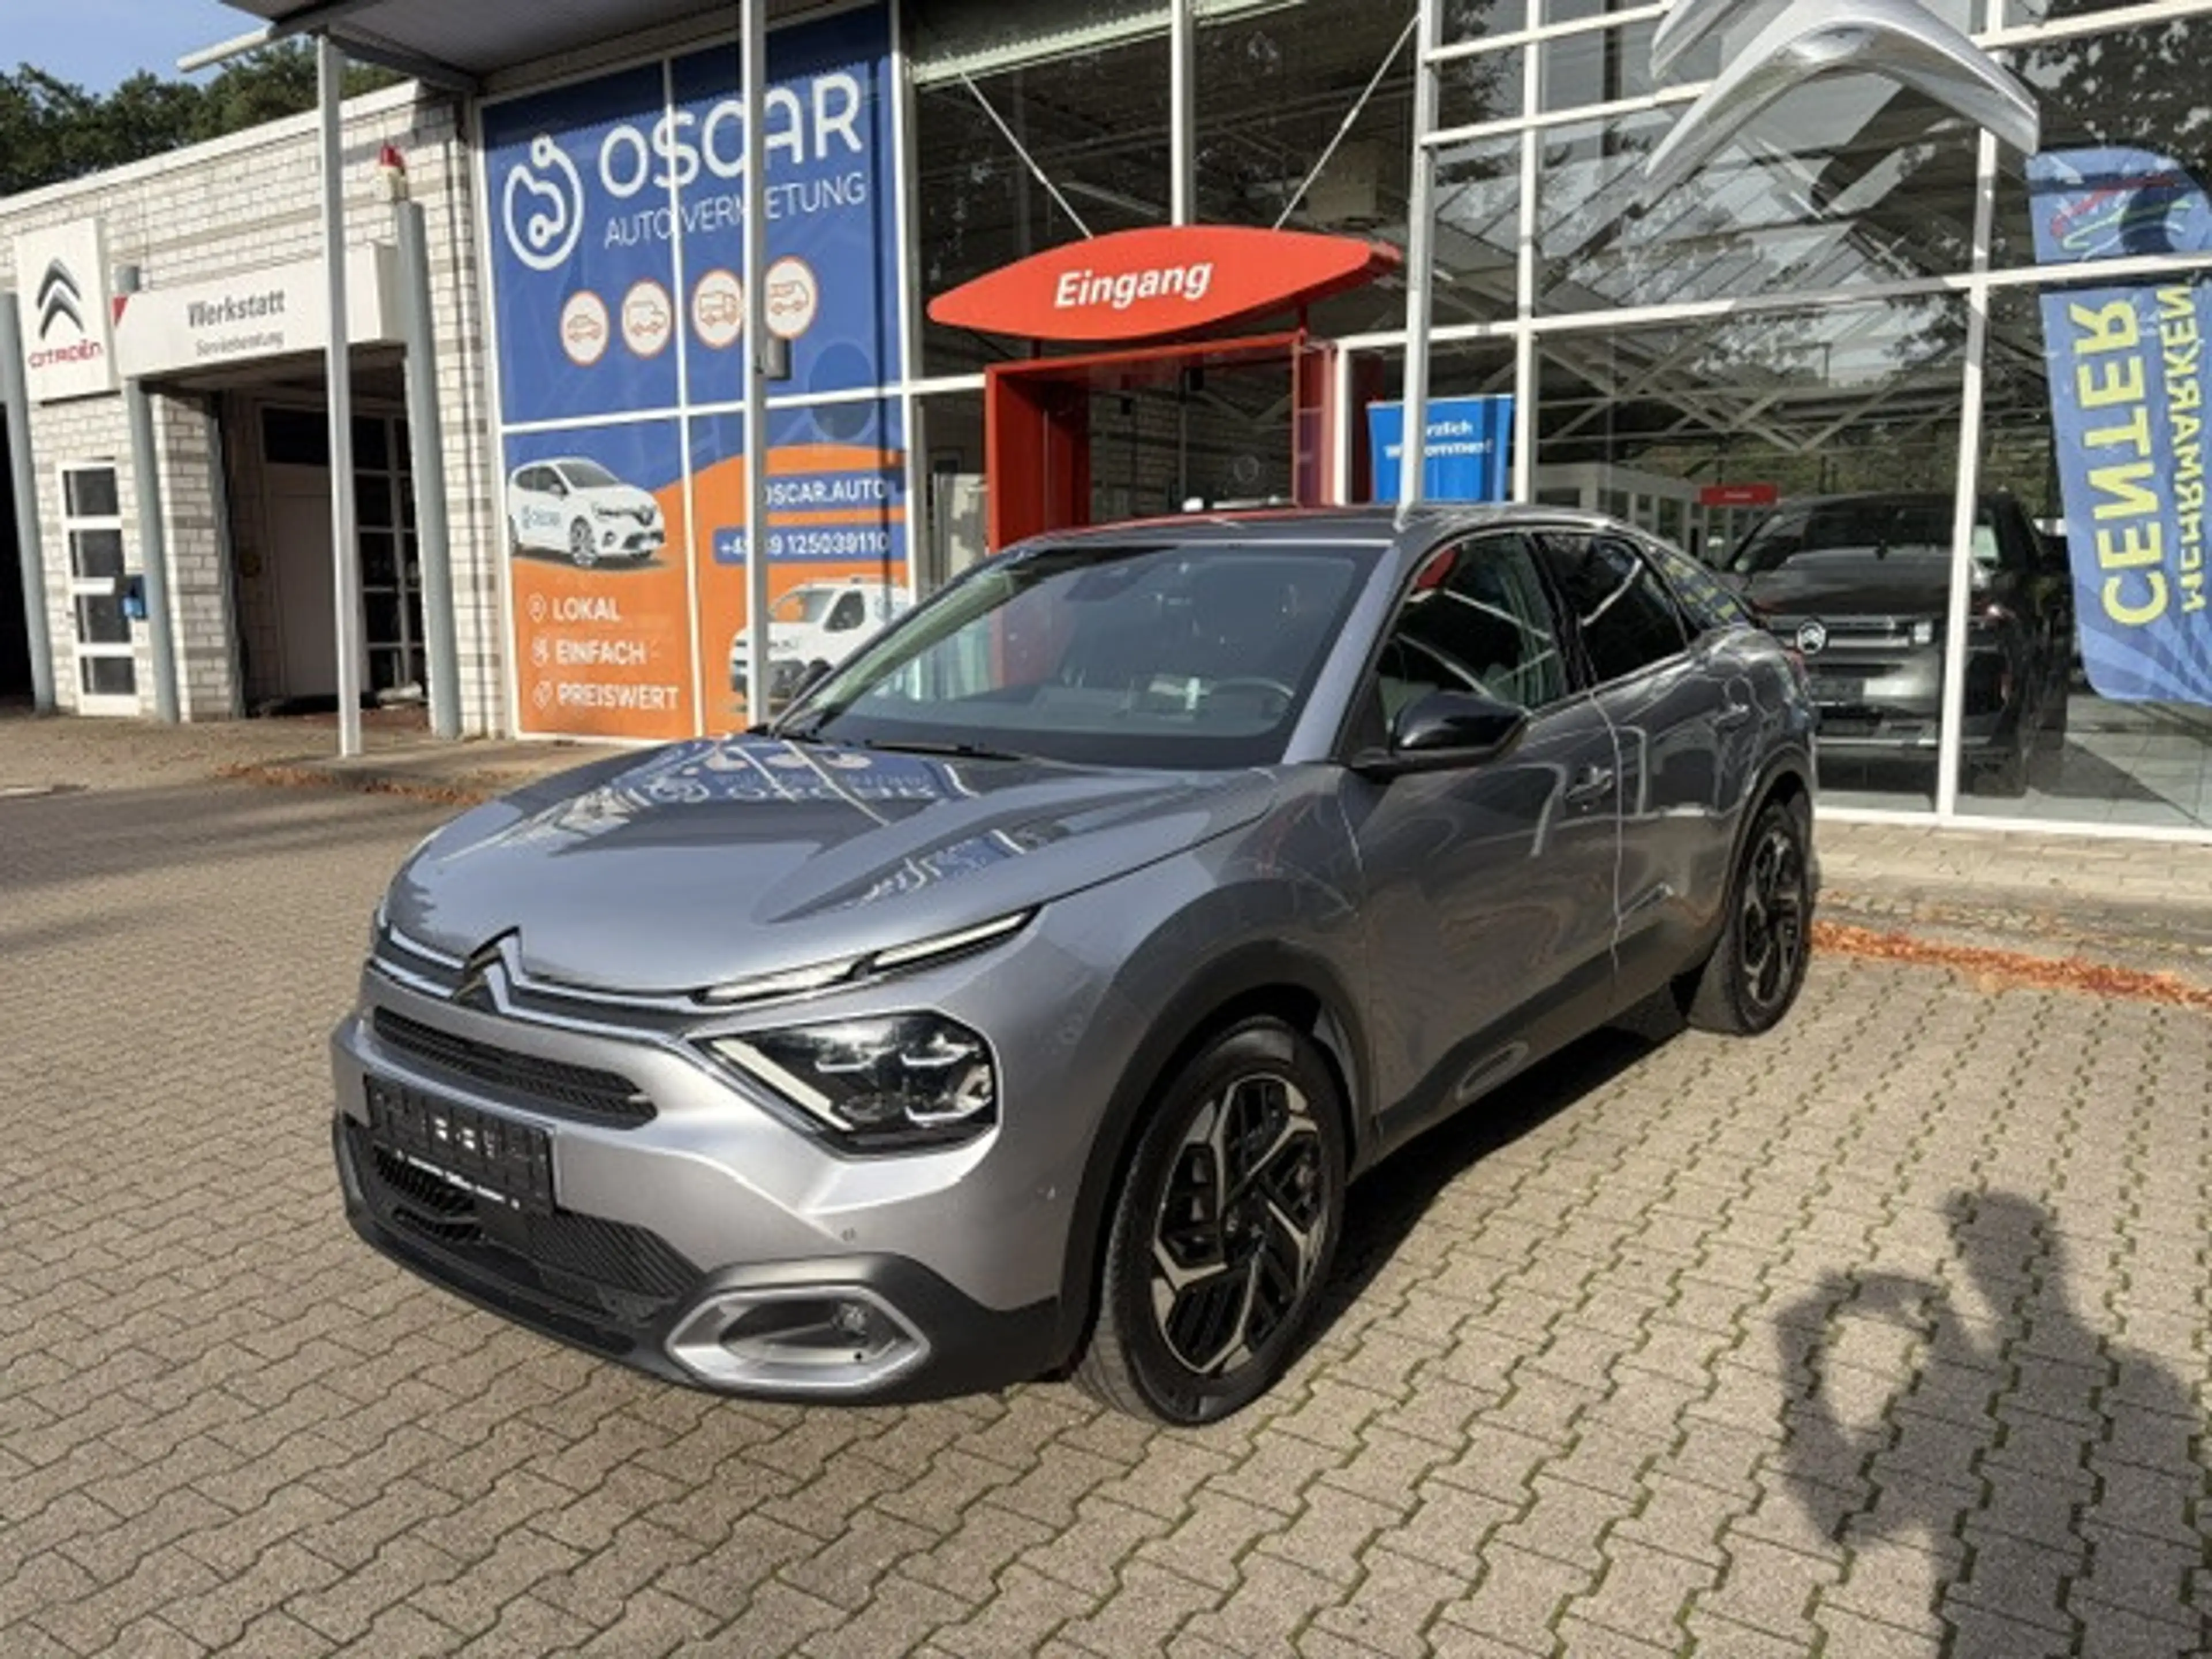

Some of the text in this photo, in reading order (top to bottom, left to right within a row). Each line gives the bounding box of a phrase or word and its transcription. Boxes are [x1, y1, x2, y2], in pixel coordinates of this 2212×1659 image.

[599, 72, 862, 198] OSCAR
[604, 172, 866, 249] AUTOVERETUNG
[1054, 260, 1213, 309] Eingang
[187, 290, 286, 328] Werkstatt
[552, 597, 622, 622] LOKAL
[555, 638, 647, 665] EINFACH
[557, 682, 680, 710] PREISWERT
